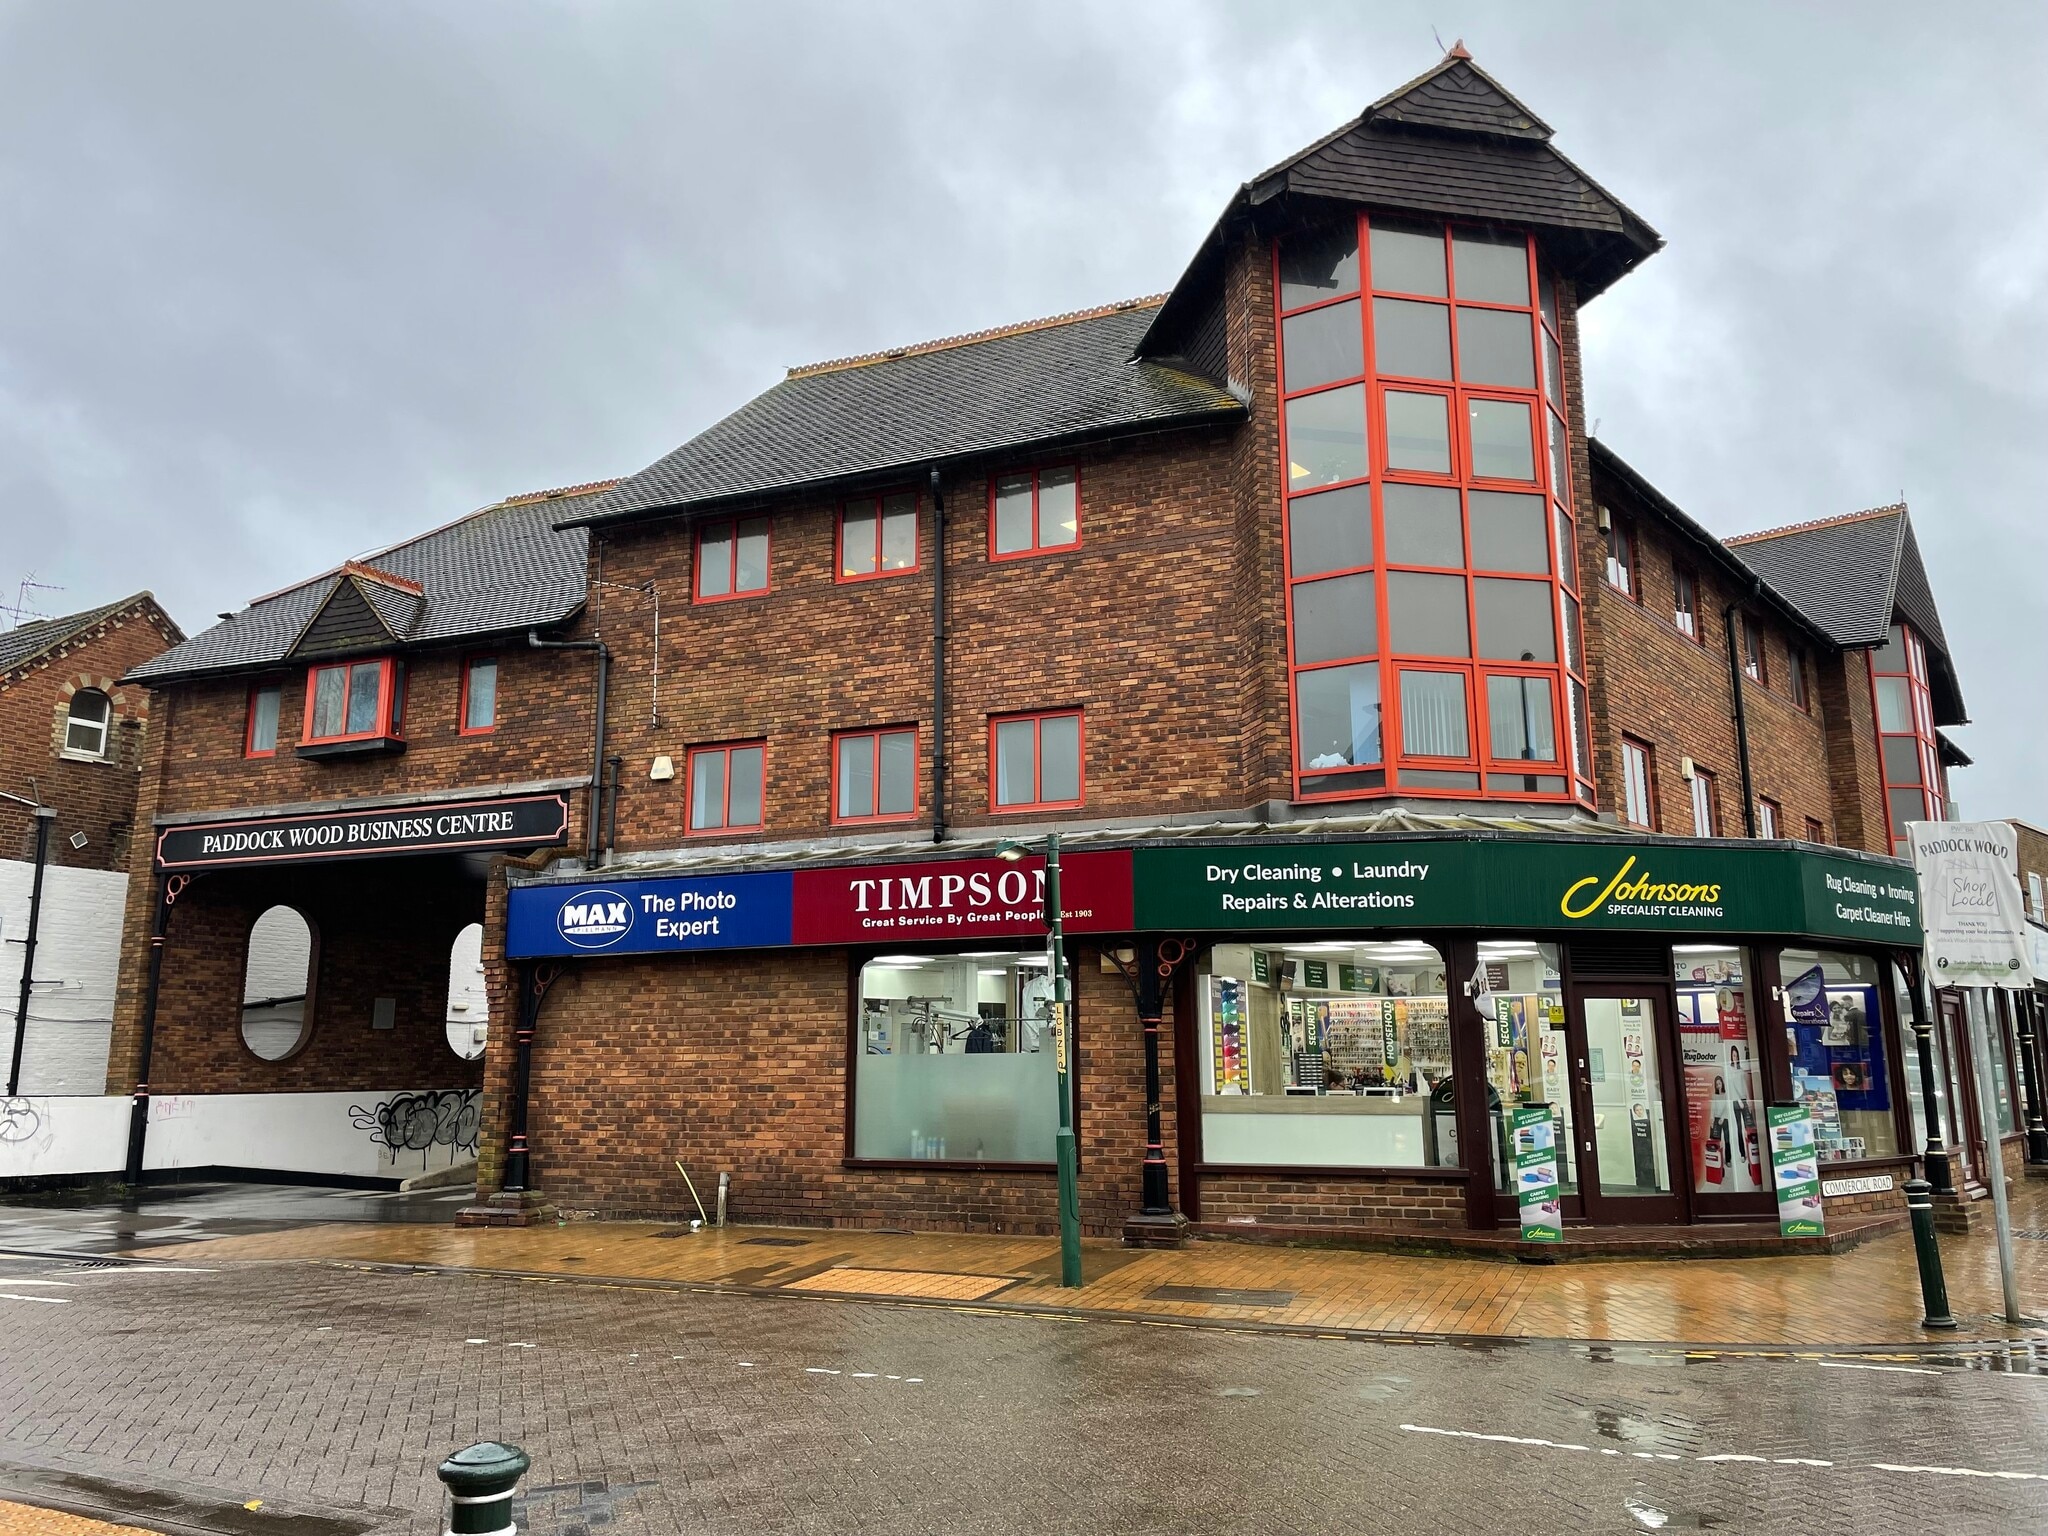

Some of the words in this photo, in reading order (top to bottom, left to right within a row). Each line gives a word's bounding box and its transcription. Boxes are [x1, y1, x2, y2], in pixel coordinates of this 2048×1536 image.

[202, 829, 285, 853] PADDOCK
[288, 825, 344, 847] WOOD
[347, 817, 433, 843] BUSINESS
[436, 811, 514, 836] CENTRE
[1919, 839, 1972, 858] PADDOCK
[1974, 840, 2009, 859] WOOD
[1206, 865, 1239, 884] Dry
[1243, 863, 1322, 883] Cleaning
[1353, 861, 1429, 881] Laundry
[1560, 855, 1721, 919] Johnsons
[1826, 873, 1843, 894] Rug
[1843, 876, 1878, 899] Cleaning
[1887, 883, 1915, 904] Ironing
[1953, 875, 1987, 897] Shop
[641, 894, 676, 913] The
[680, 891, 737, 912] Photo
[1222, 893, 1288, 913] Repairs
[1293, 892, 1308, 909] &
[1311, 891, 1414, 909] Alterations
[1952, 891, 1995, 907] Local
[563, 902, 627, 927] MAX
[862, 917, 895, 928] Great
[898, 915, 943, 926] Service
[947, 914, 963, 925] By
[966, 912, 1001, 923] Great
[1074, 910, 1093, 918] 1903
[1607, 904, 1667, 916] SPECIALIST
[1668, 905, 1724, 917] CLEANING
[1836, 903, 1864, 923] Carpet
[1864, 907, 1894, 925] Cleaner
[1893, 910, 1911, 927] Hire
[572, 925, 618, 933] SPIELMANN
[656, 916, 720, 941] Expert
[1307, 1003, 1317, 1046] SECURITY
[1383, 1001, 1395, 1060] HOUSEHOLD
[1498, 998, 1510, 1045] SECURITY
[1824, 1180, 1871, 1195] COMMERCIAL
[1873, 1176, 1892, 1190] ROAD
